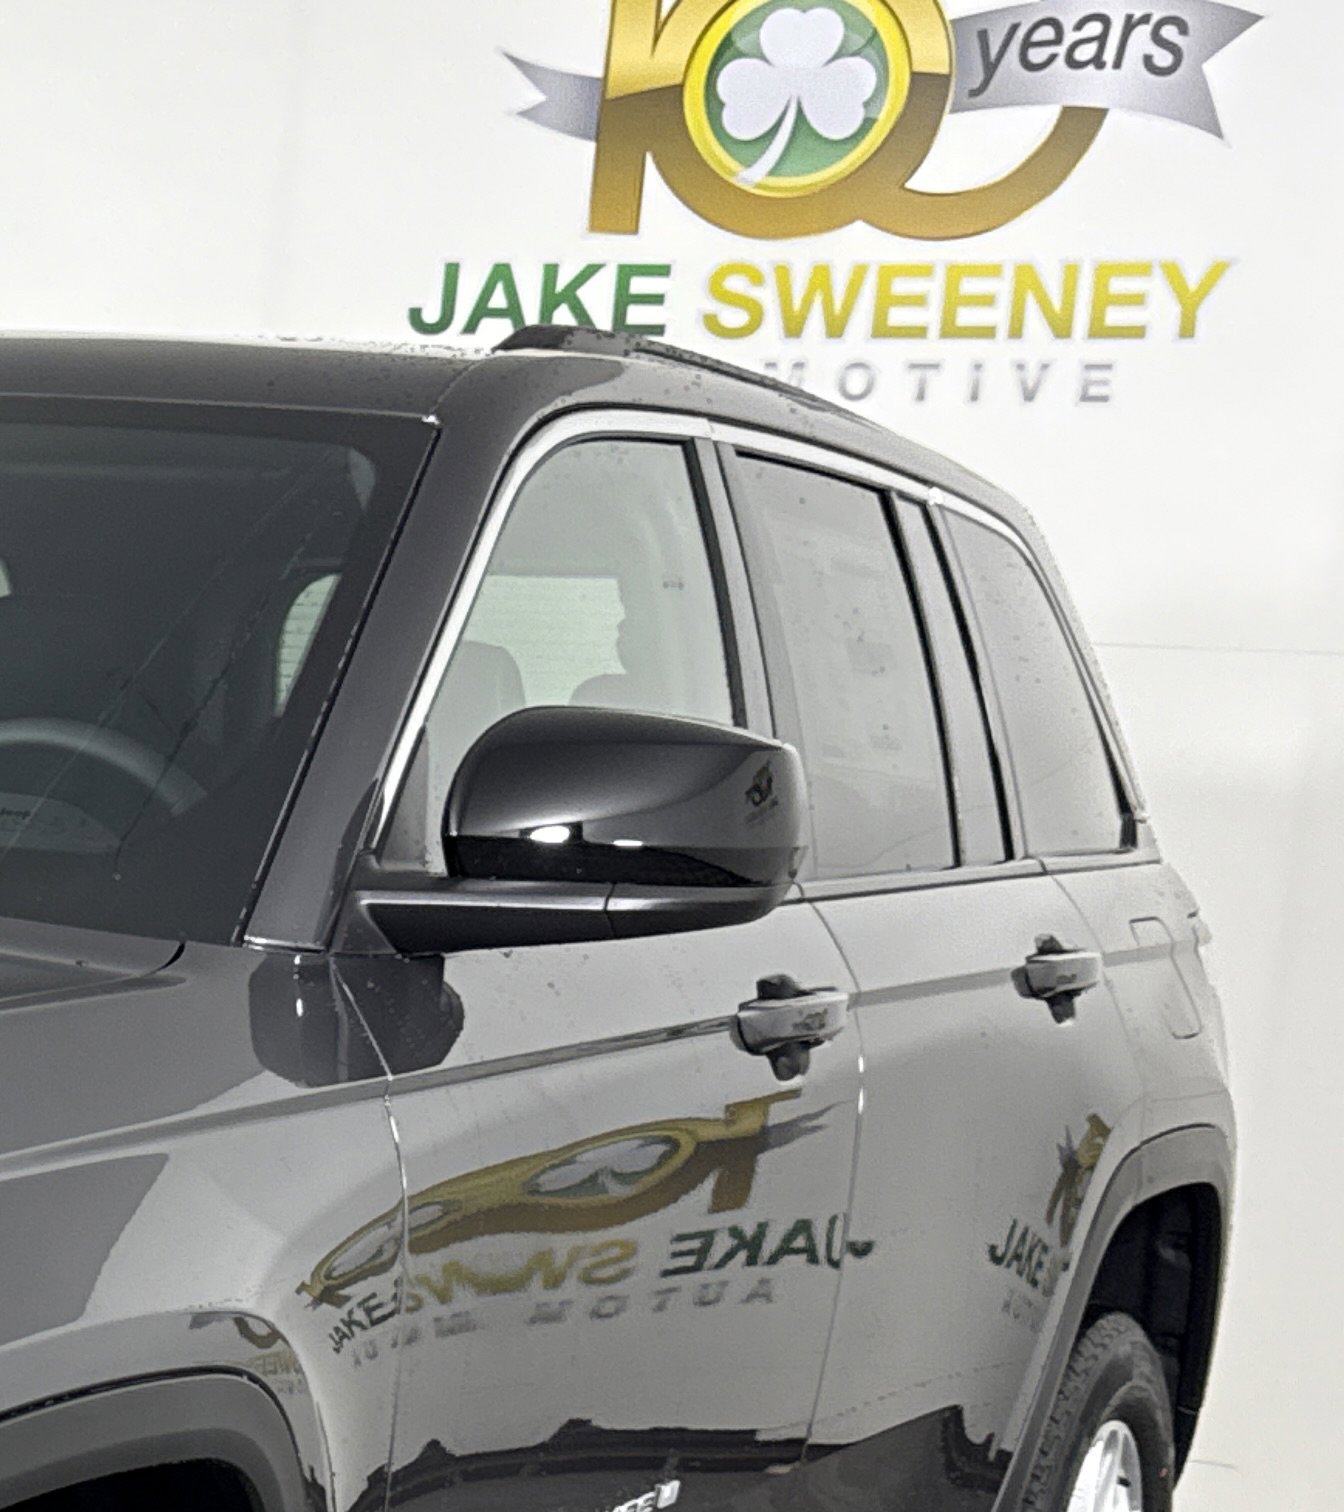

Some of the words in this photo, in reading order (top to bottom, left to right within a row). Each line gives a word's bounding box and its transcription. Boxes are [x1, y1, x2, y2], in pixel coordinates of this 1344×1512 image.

[967, 12, 1189, 98] years
[408, 262, 672, 336] JAKE
[702, 261, 1229, 341] SWEENEY
